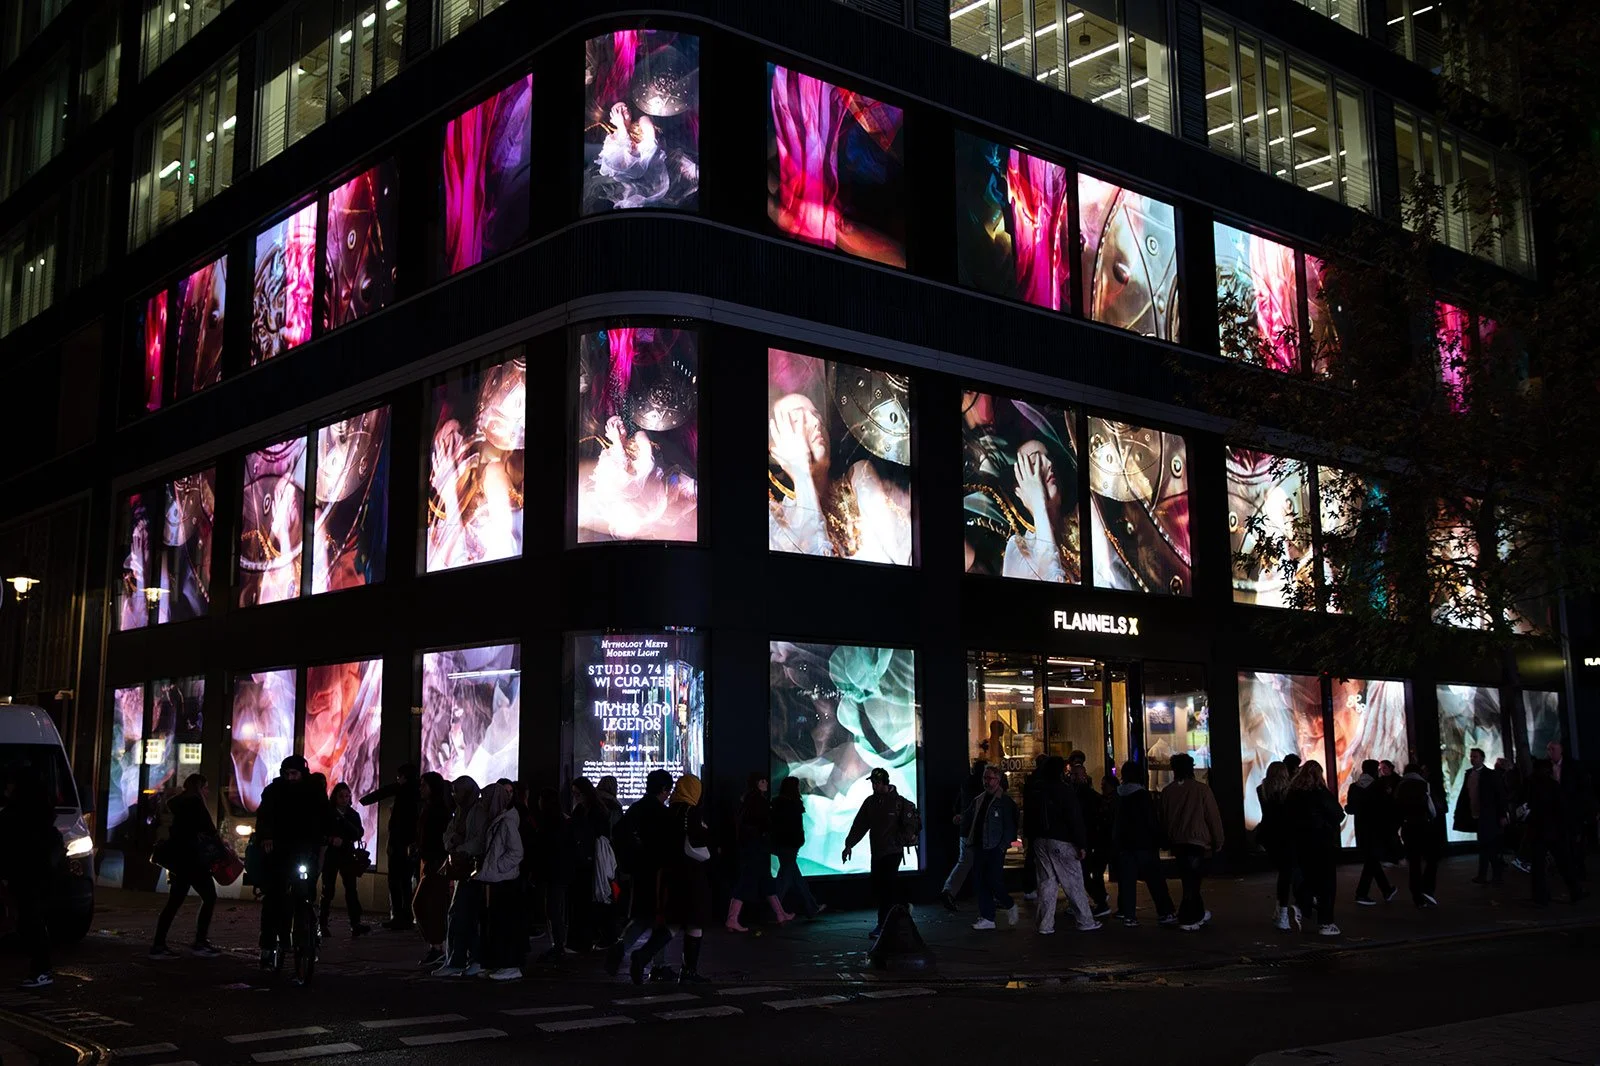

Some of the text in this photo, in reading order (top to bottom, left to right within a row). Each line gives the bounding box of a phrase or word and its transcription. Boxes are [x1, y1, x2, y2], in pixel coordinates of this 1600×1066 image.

[1054, 610, 1139, 636] FLANNELS X
[601, 640, 668, 649] MYTHOLOGY MEETS
[606, 649, 660, 657] MODERN LIGHT
[588, 664, 642, 676] STUDIO
[647, 664, 662, 675] 74
[614, 677, 671, 688] CURATES
[594, 700, 640, 719] MYTHS
[602, 717, 661, 733] LEGENDS
